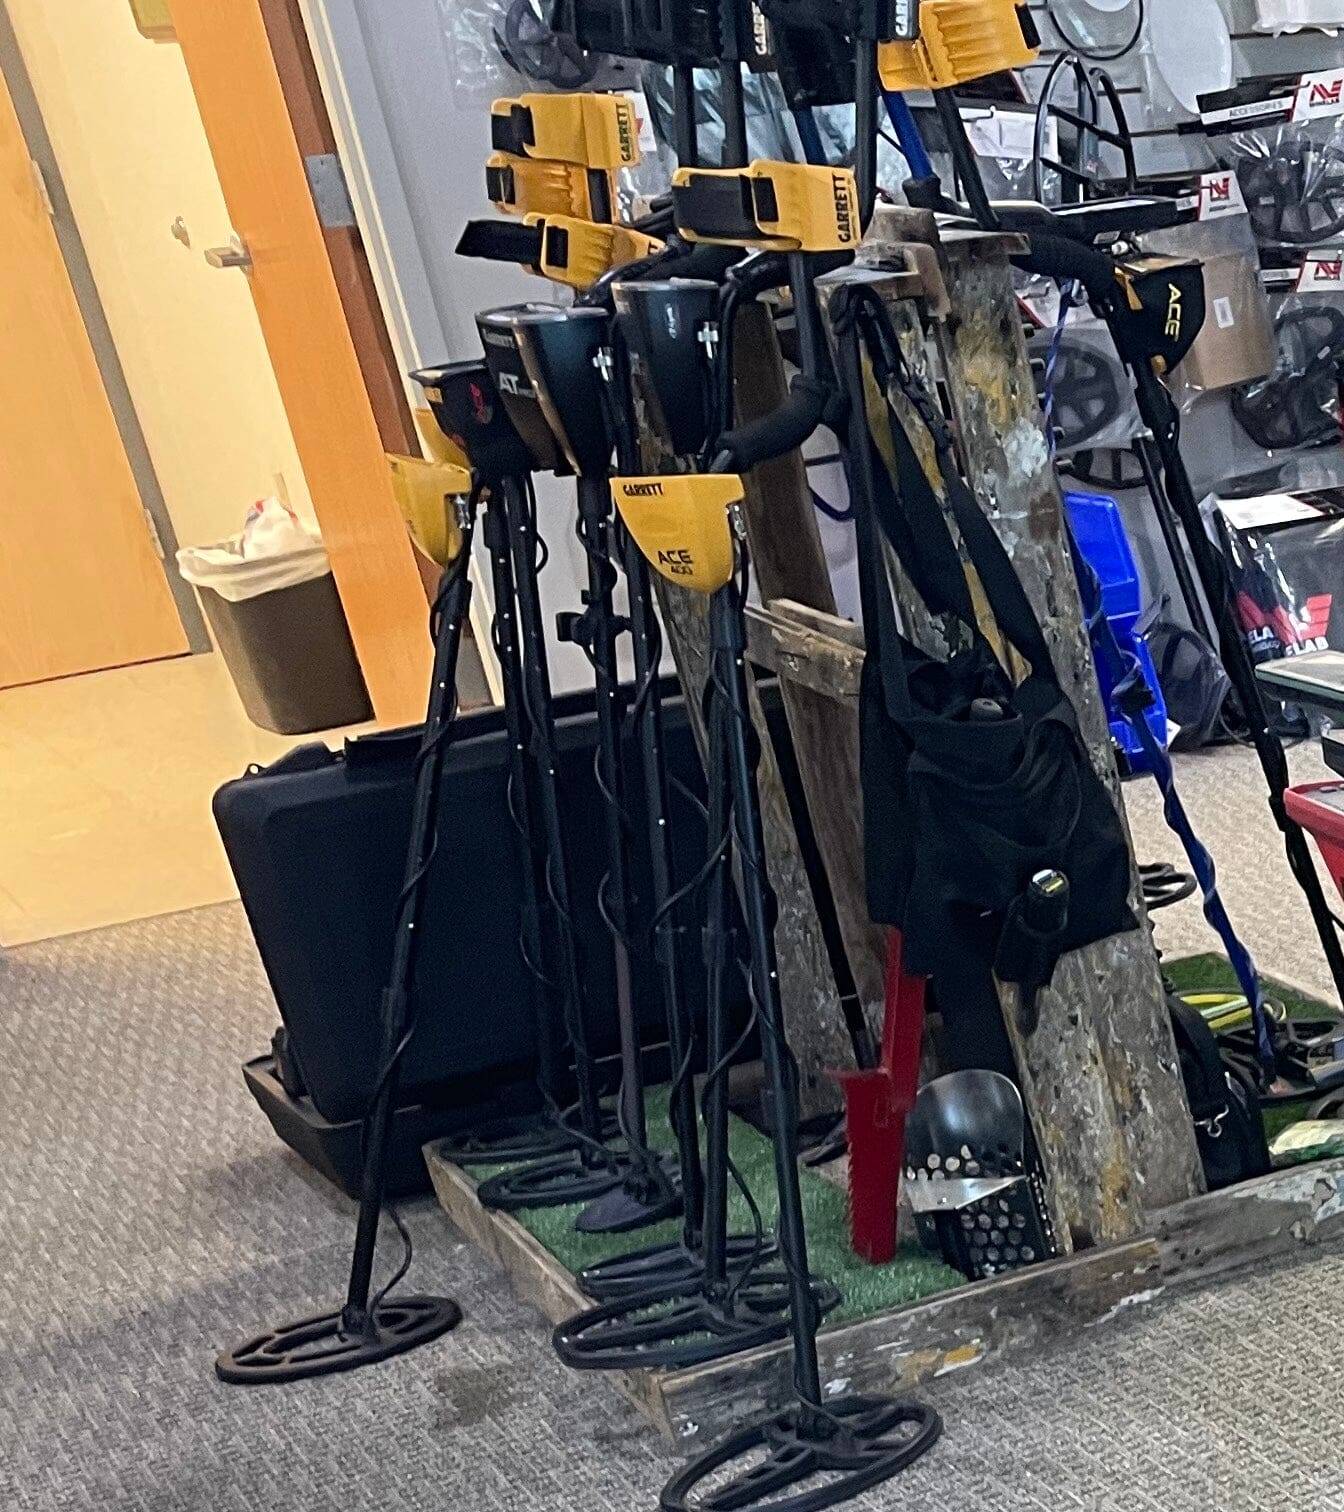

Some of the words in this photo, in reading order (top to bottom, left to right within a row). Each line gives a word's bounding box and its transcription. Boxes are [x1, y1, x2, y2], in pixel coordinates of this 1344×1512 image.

[615, 102, 632, 162] GARRETT
[832, 172, 851, 243] GARRETT
[1164, 283, 1182, 342] ACE
[623, 482, 663, 497] GARRETT
[657, 549, 694, 565] ACE
